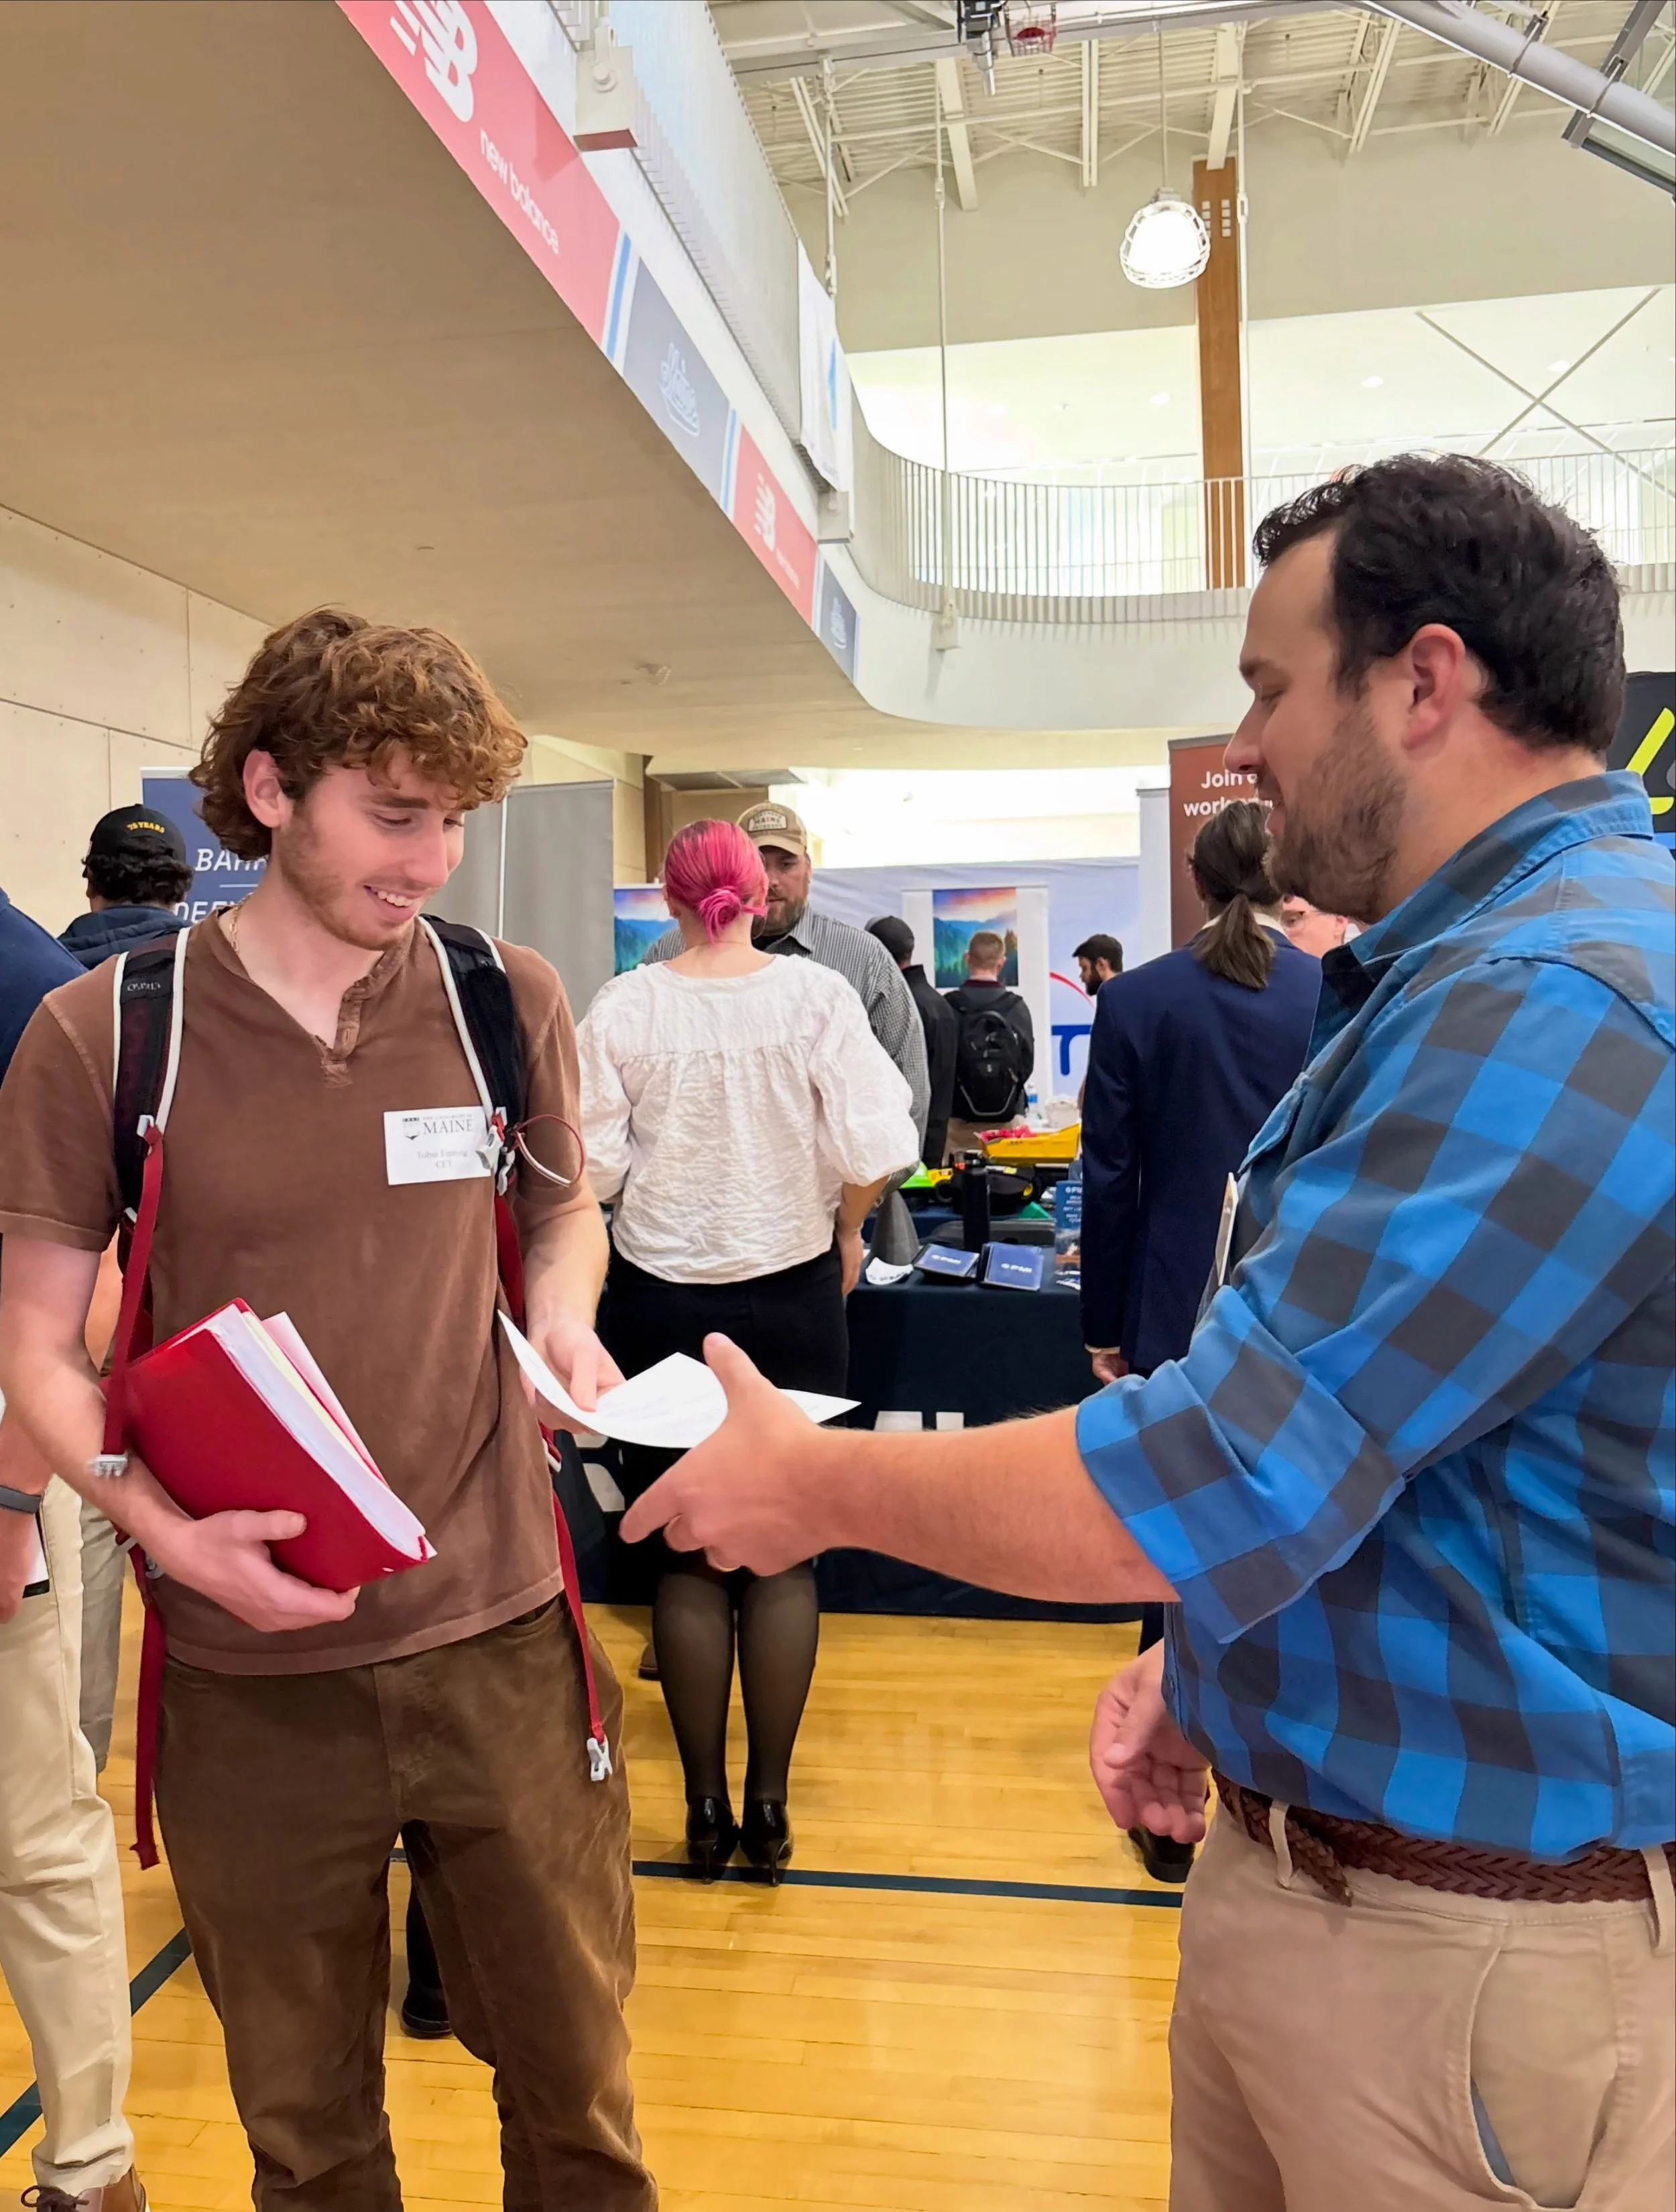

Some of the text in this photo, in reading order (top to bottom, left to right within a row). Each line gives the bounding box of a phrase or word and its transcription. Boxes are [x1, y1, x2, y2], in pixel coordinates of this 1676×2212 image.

[480, 128, 559, 255] new balance
[1201, 769, 1242, 789] Join
[138, 821, 166, 834] YEARS
[423, 1119, 473, 1134] MAINE
